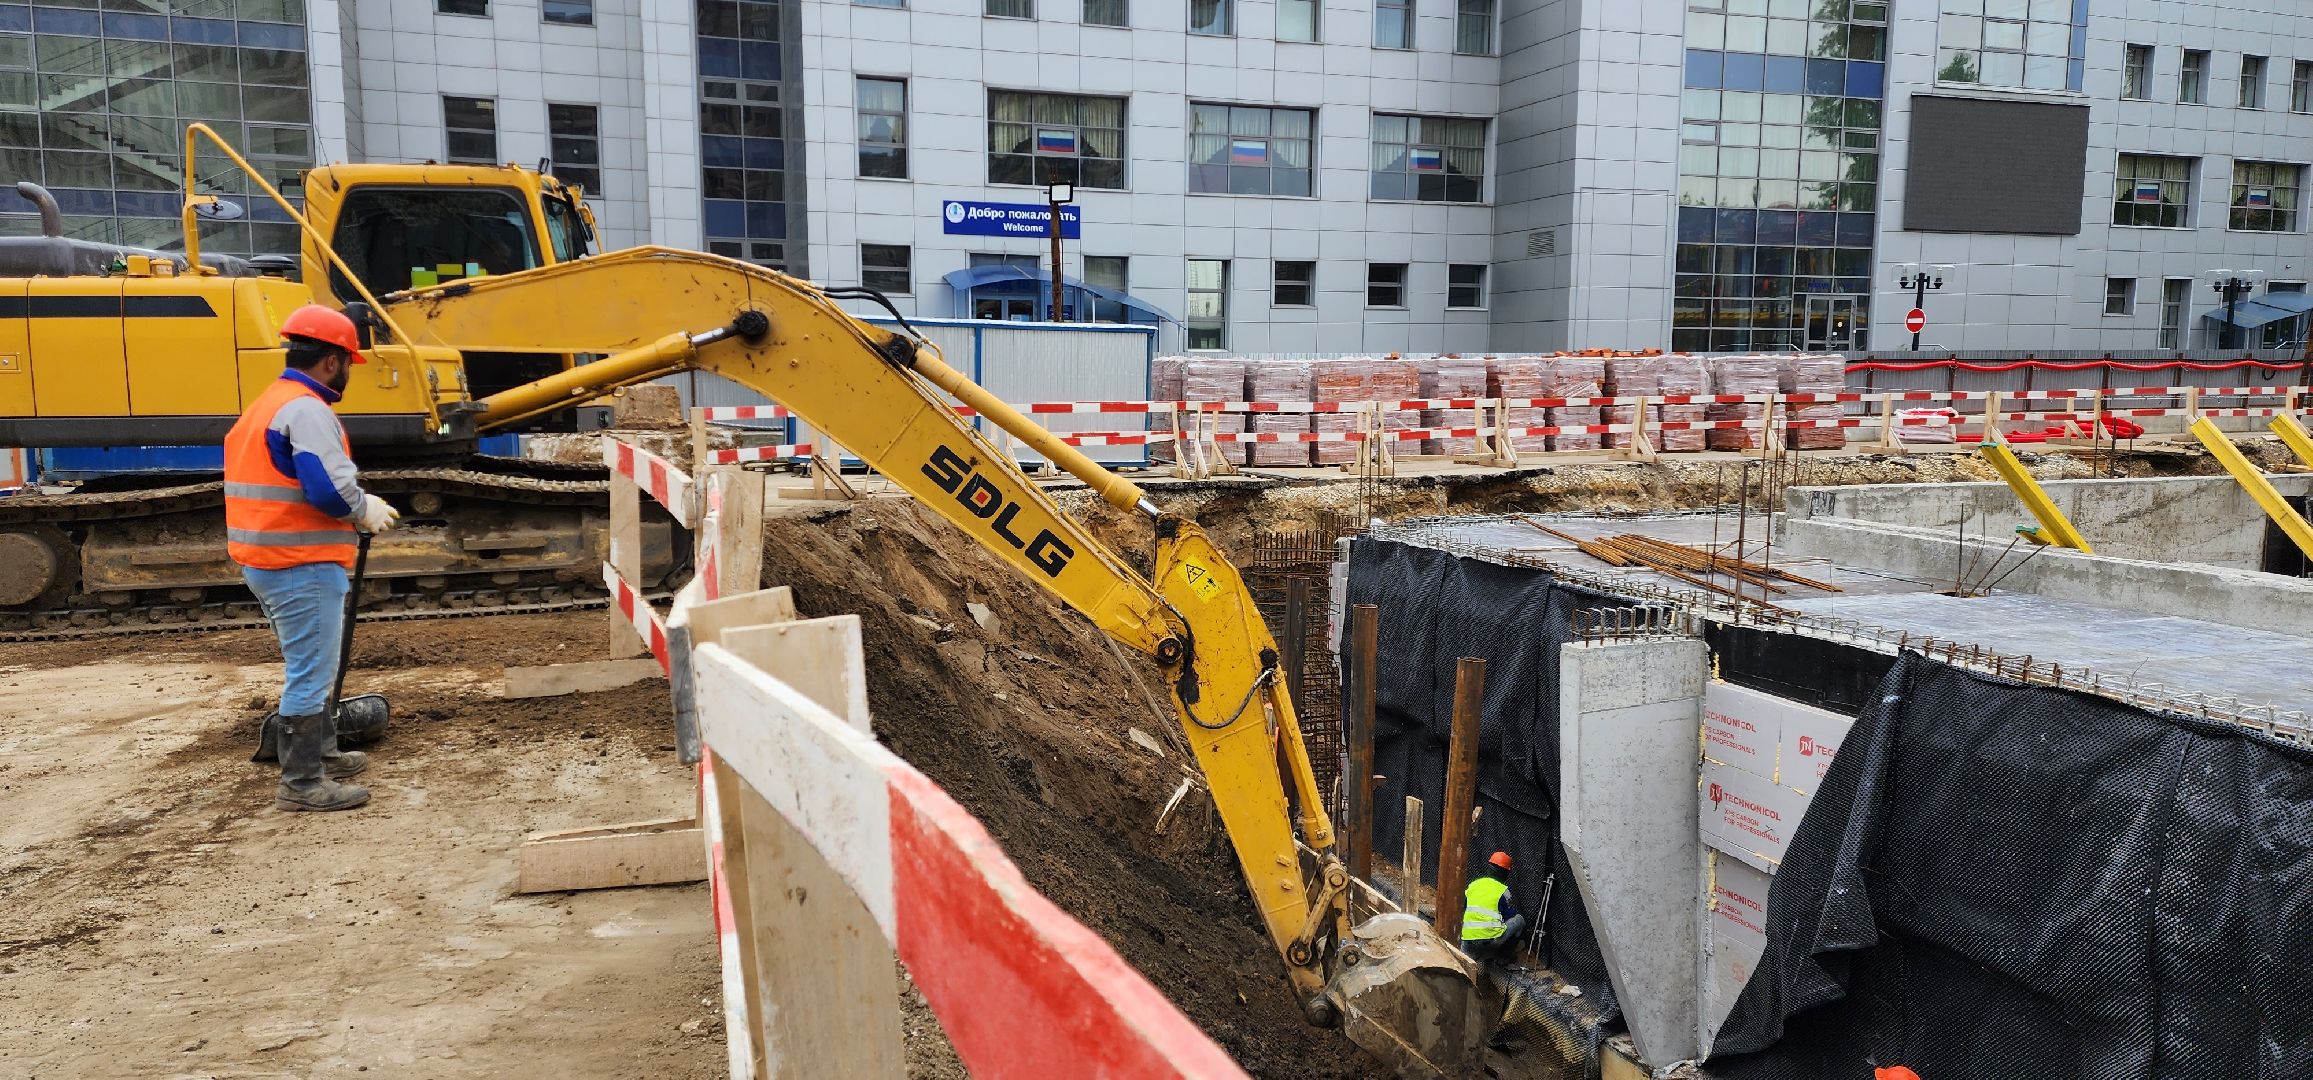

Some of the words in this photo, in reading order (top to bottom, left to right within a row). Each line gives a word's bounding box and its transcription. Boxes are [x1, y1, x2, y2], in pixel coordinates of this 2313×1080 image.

[968, 207, 1005, 221] Добро
[1009, 210, 1077, 221] пожалоать
[1003, 222, 1044, 232] Welcome
[921, 444, 1075, 578] SDLG
[1705, 710, 1757, 733] ECHNONICOL
[1724, 792, 1781, 822] TECHNONICOL
[1724, 816, 1736, 826] FOR
[1737, 821, 1780, 845] PROFESSIONALS
[1736, 813, 1760, 827] CARBON
